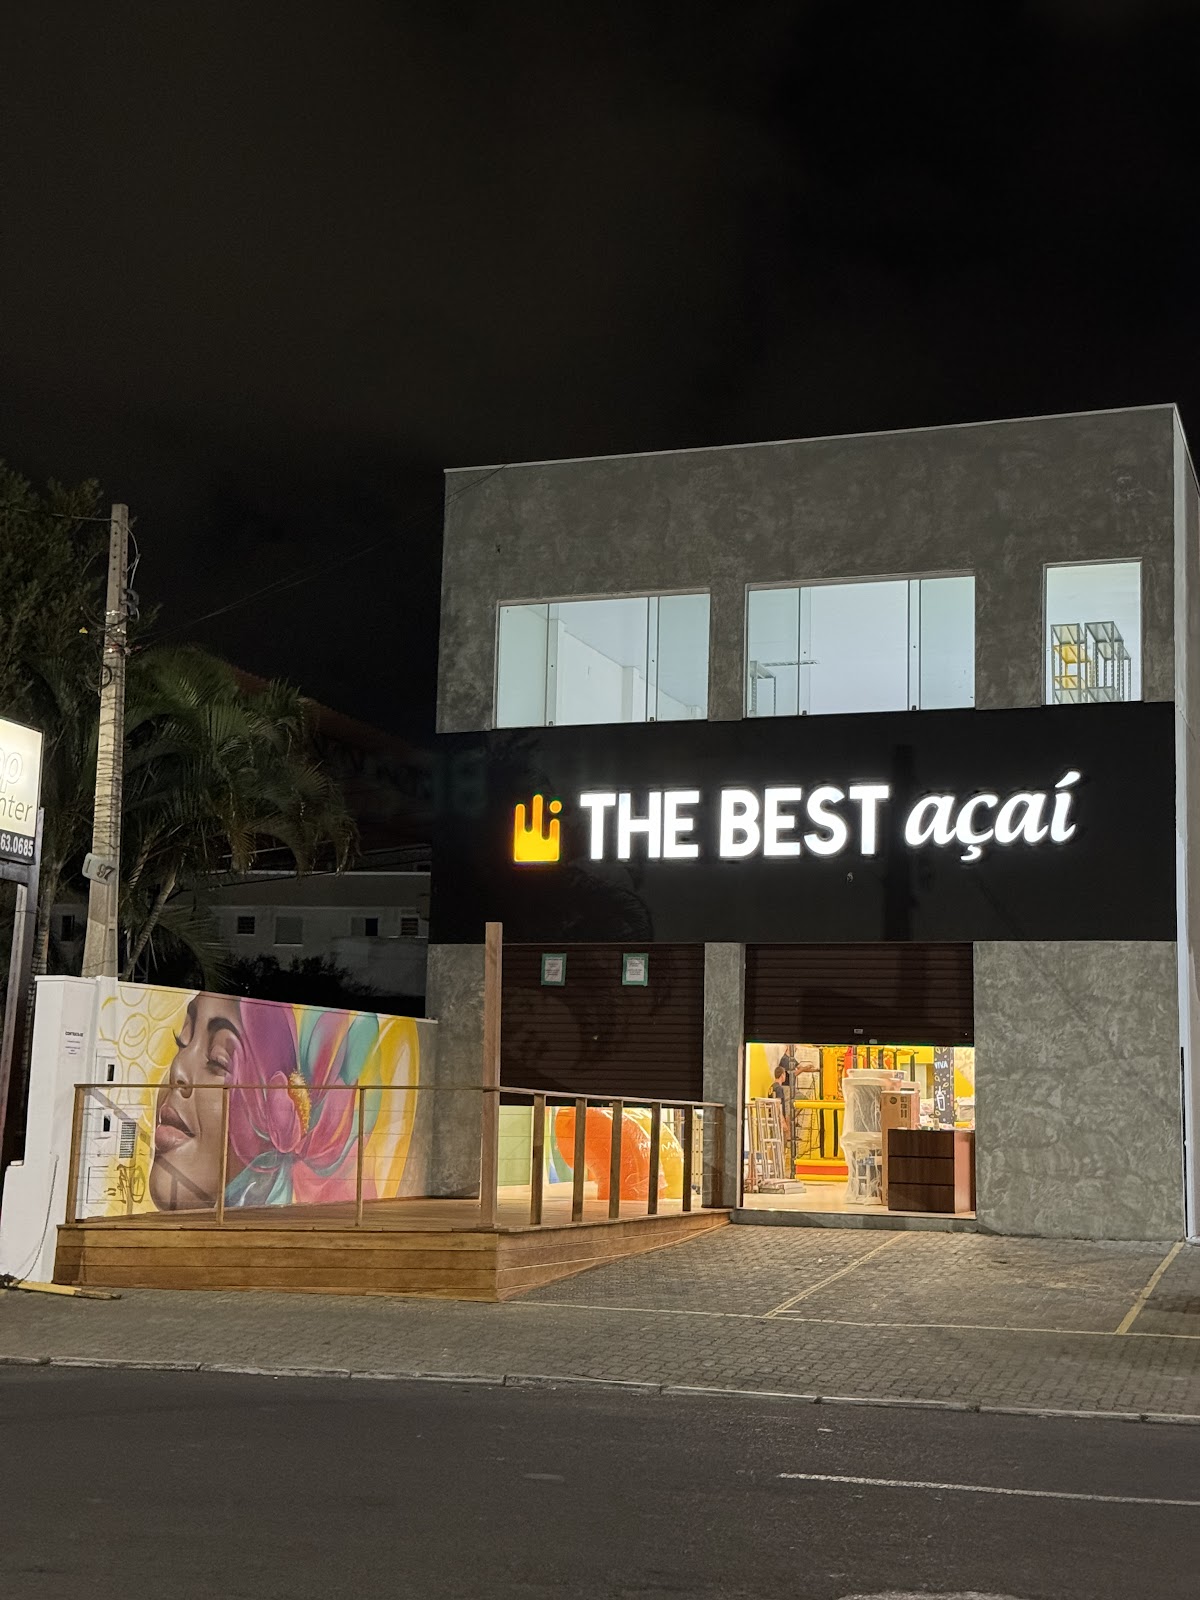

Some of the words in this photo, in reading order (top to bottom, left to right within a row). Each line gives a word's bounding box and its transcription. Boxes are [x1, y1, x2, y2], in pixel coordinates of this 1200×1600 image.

[580, 790, 700, 860] THE
[719, 785, 889, 856] BEST
[904, 771, 1081, 861] açaí
